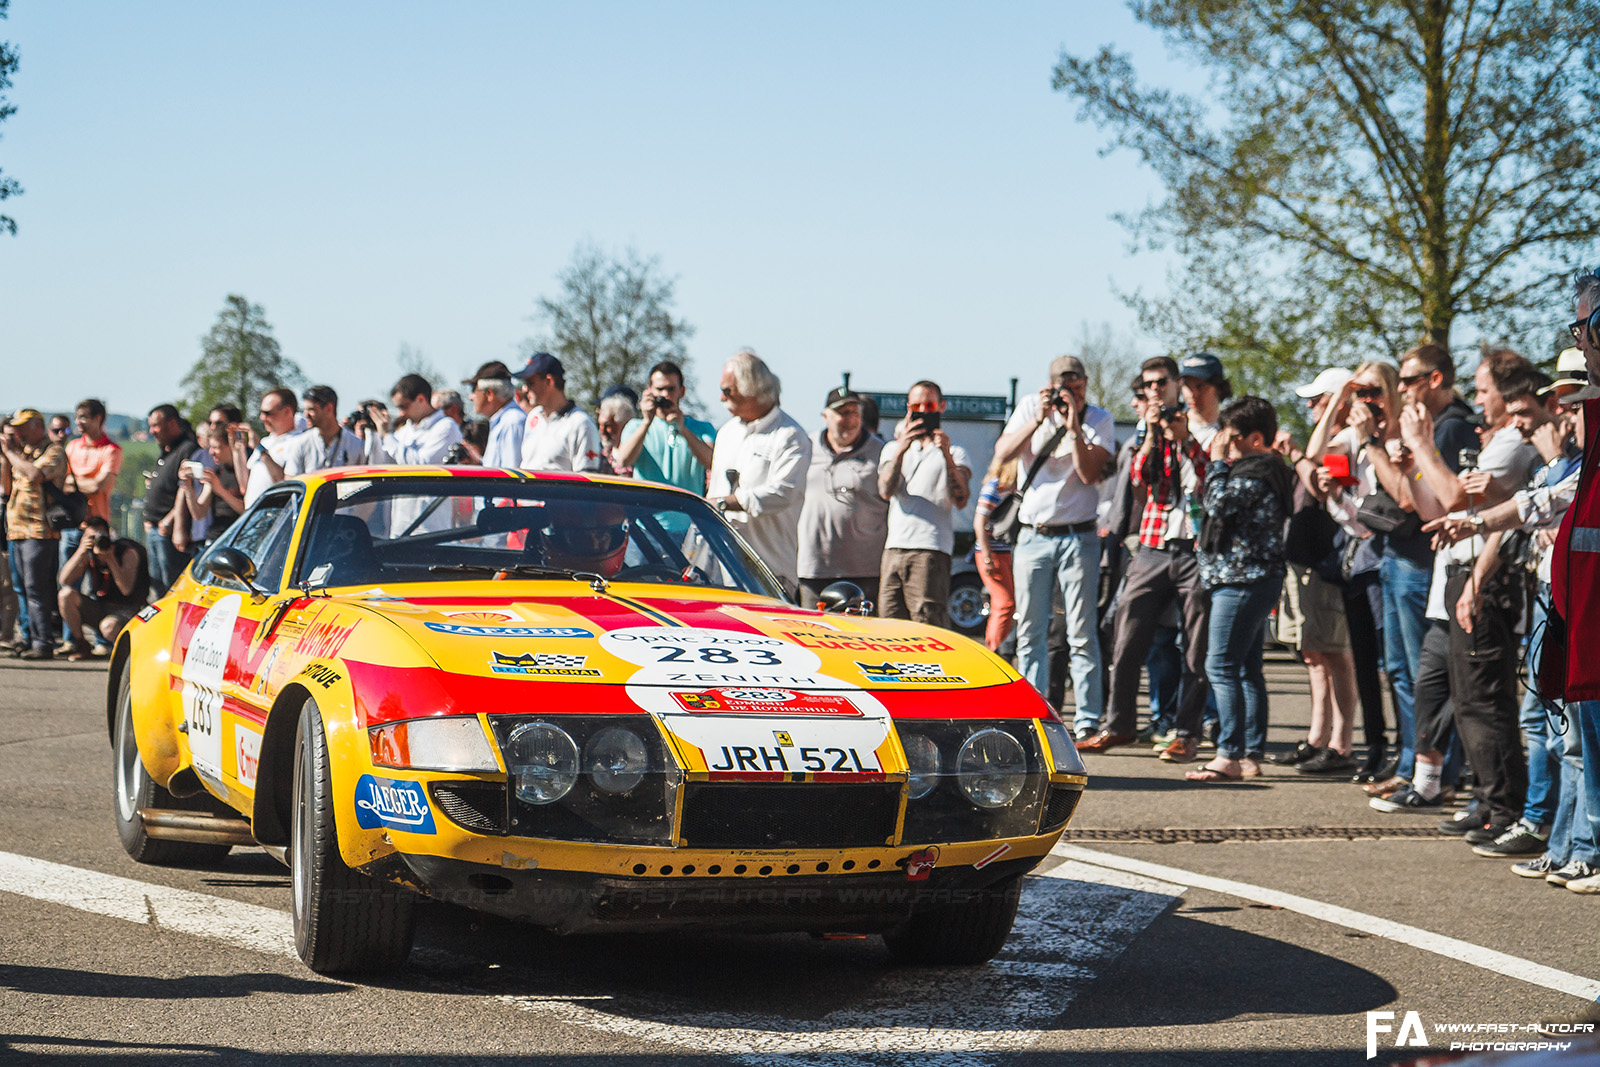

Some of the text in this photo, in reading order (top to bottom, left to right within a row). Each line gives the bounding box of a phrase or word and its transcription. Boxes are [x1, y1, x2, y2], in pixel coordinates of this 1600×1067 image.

[293, 603, 363, 660] Luchard
[430, 623, 588, 637] JAEGER
[791, 631, 926, 642] PLASTIQUE
[610, 633, 783, 647] Optic 2000
[780, 631, 956, 653] Luchard
[651, 646, 782, 665] 283
[526, 668, 600, 676] MARCHAL
[666, 673, 816, 684] ZENITH
[731, 690, 787, 700] 283
[192, 681, 212, 736] 283
[712, 746, 879, 773] JRH 52L
[358, 783, 428, 823] JAEGER
